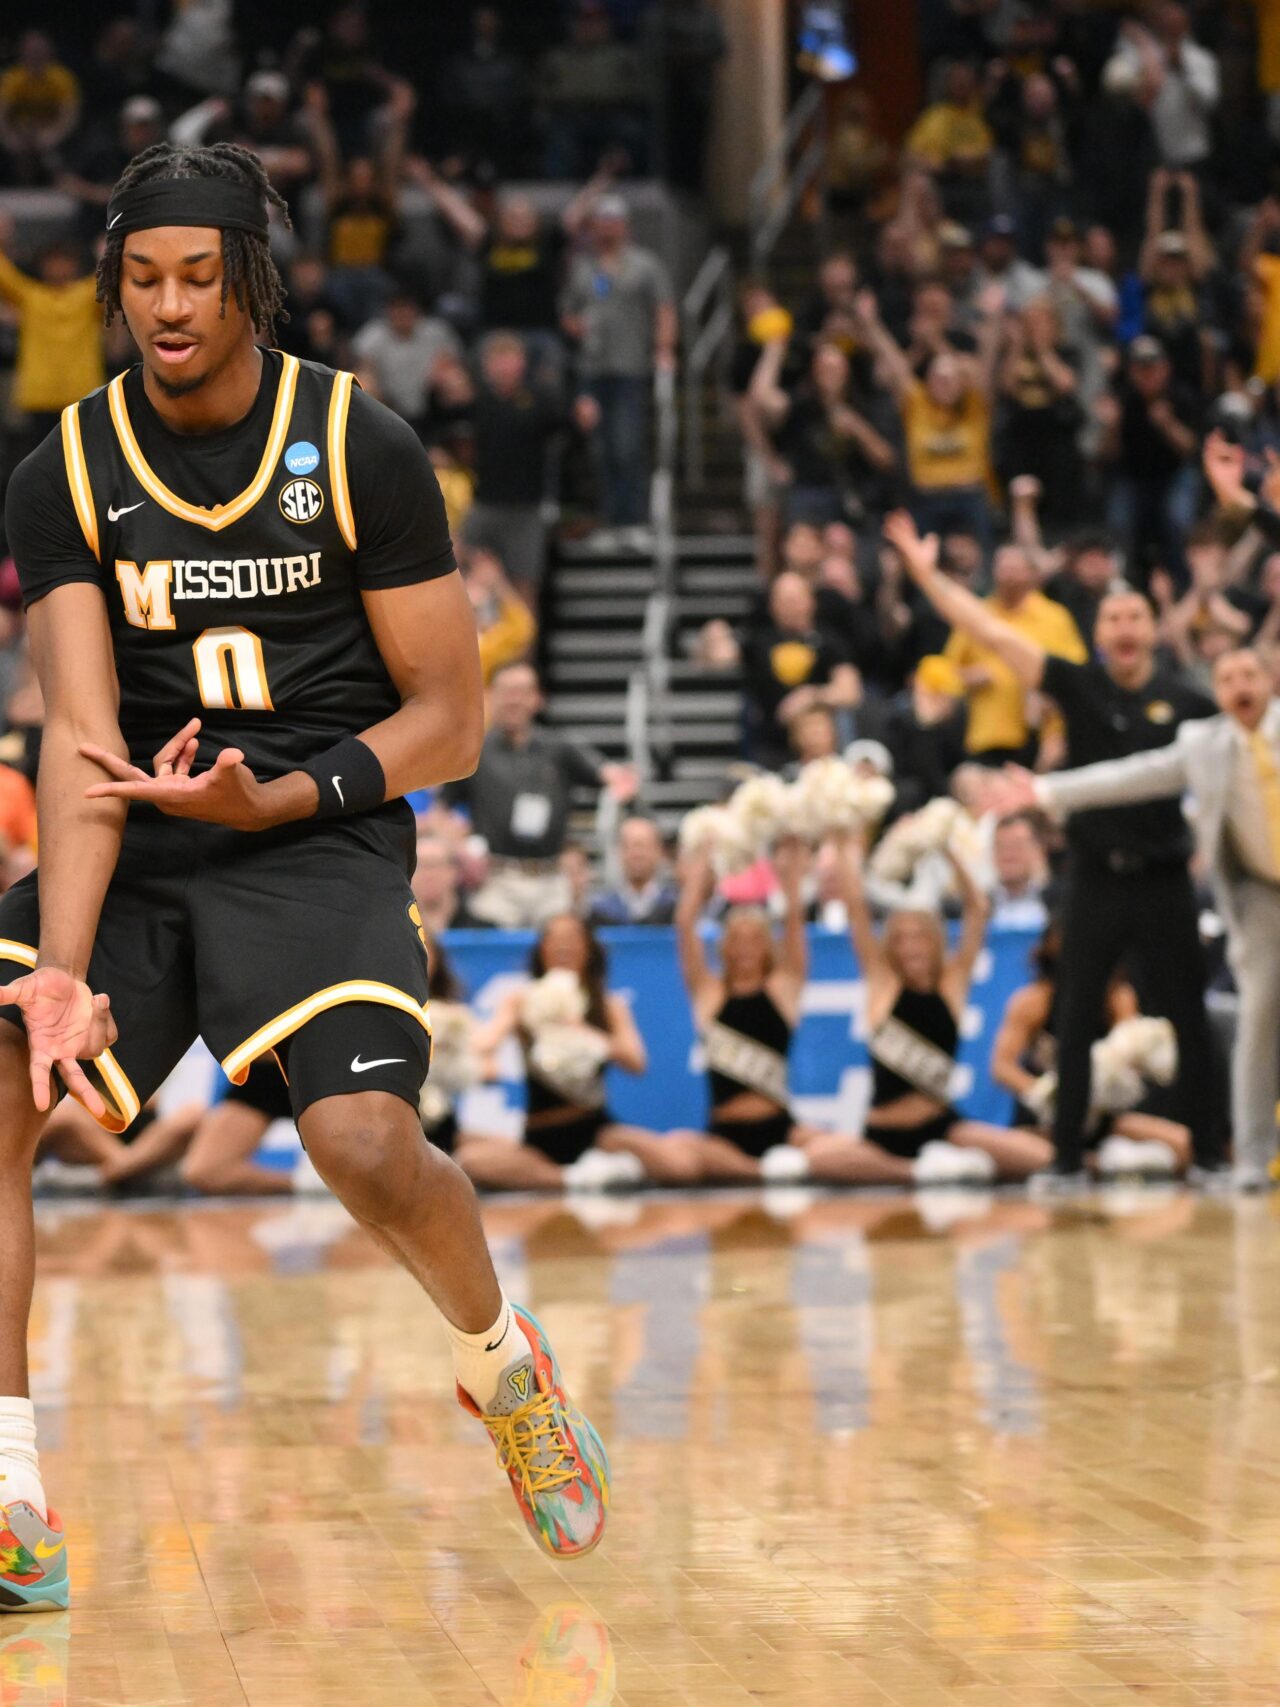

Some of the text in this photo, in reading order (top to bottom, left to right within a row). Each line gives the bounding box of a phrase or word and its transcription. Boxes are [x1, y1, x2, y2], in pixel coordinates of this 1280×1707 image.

[290, 455, 317, 468] NCAA
[281, 480, 321, 520] SEC
[115, 552, 321, 630] MISSOURI
[192, 626, 275, 711] 0
